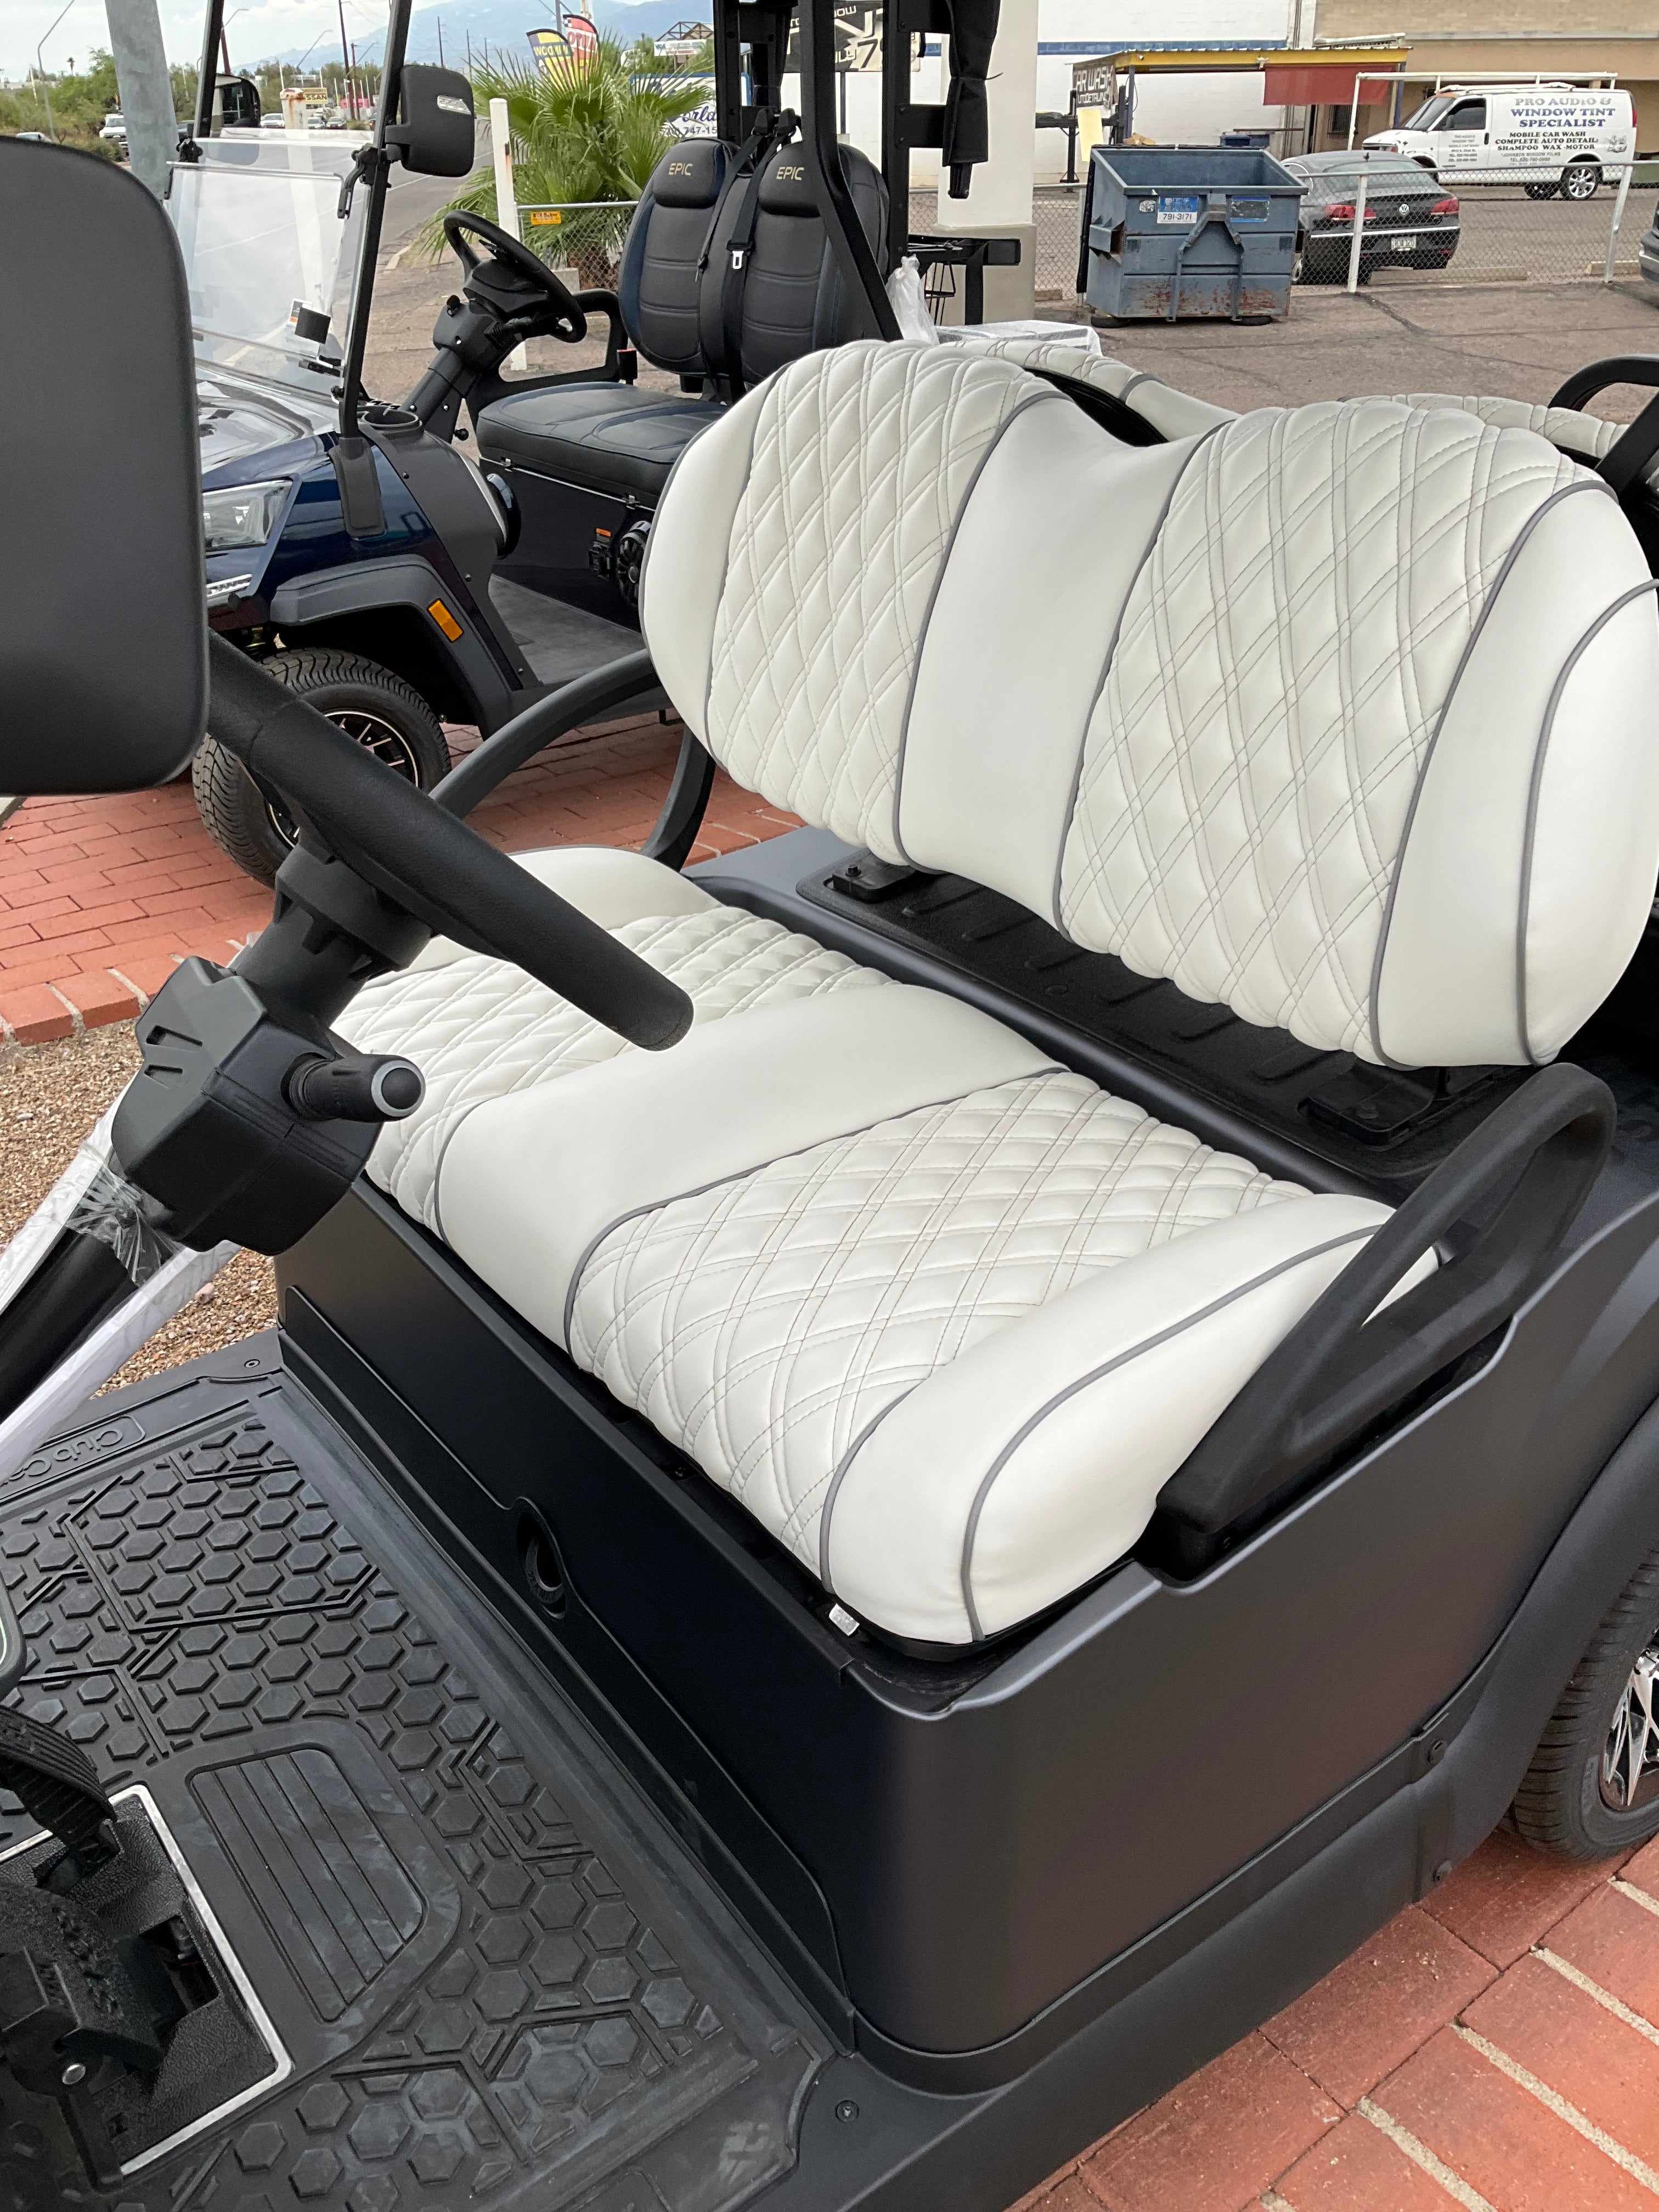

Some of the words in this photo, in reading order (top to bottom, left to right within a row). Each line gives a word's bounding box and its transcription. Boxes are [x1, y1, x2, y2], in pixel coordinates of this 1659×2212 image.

[1548, 98, 1596, 106] AUDIO
[1510, 108, 1577, 116] WINDOW
[1519, 119, 1606, 127] SPECIALIST
[668, 162, 693, 176] EPIC
[775, 166, 805, 180] EPIC
[53, 1429, 123, 1462] Club
